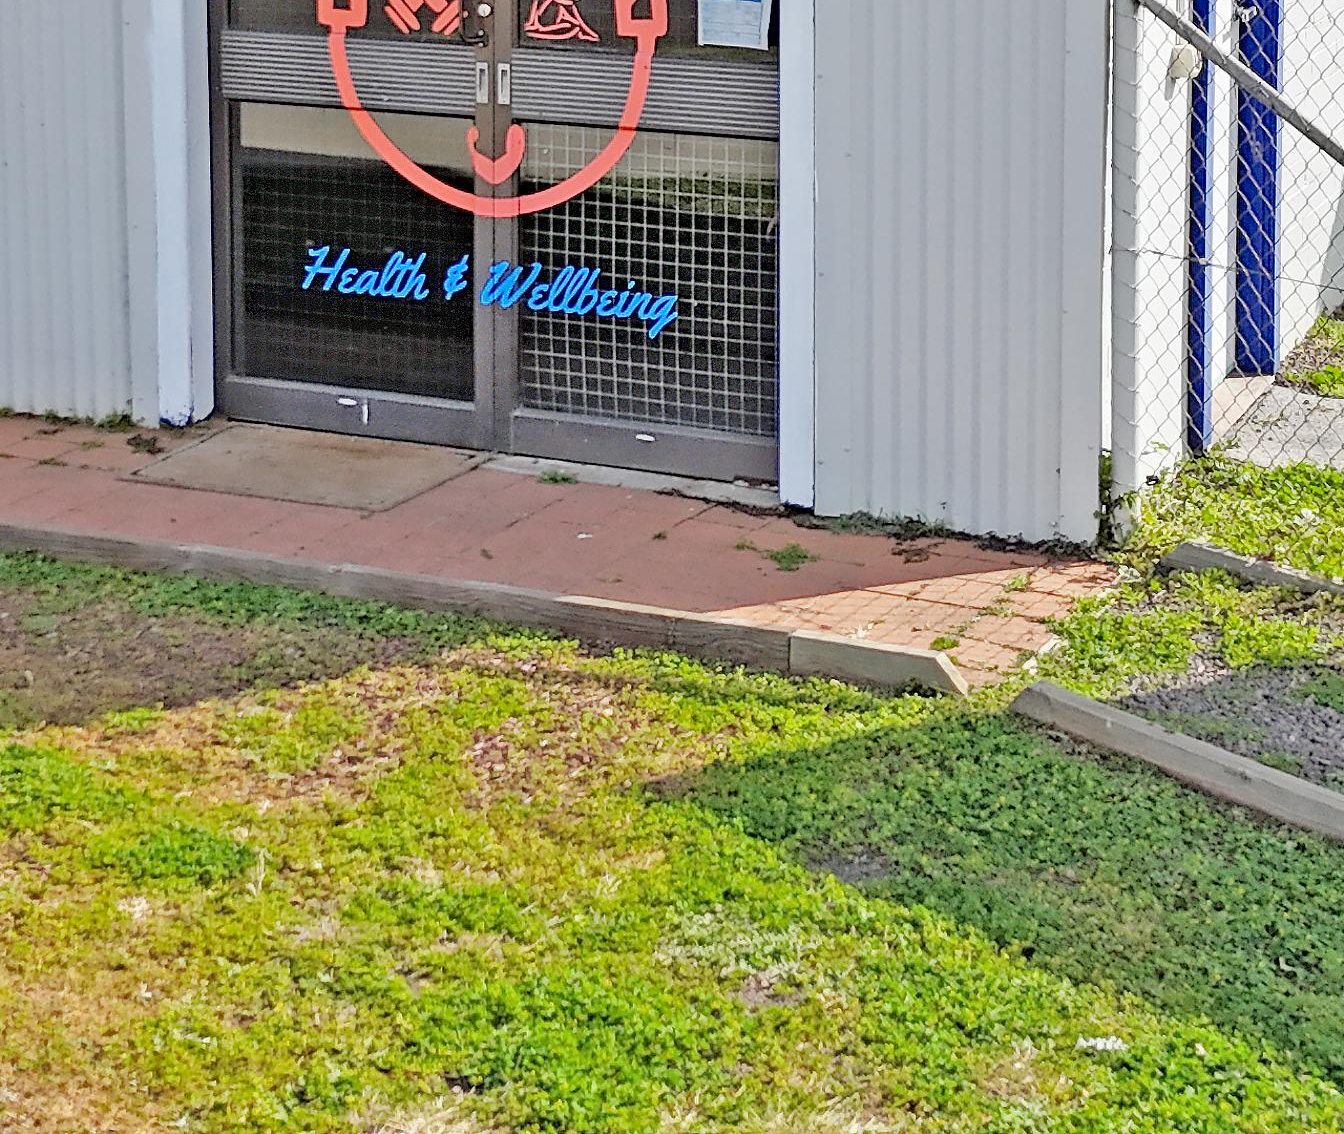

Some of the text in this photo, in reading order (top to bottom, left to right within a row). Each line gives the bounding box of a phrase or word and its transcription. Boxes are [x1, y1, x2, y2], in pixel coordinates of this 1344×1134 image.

[301, 245, 679, 340] Health & Wellbeing
